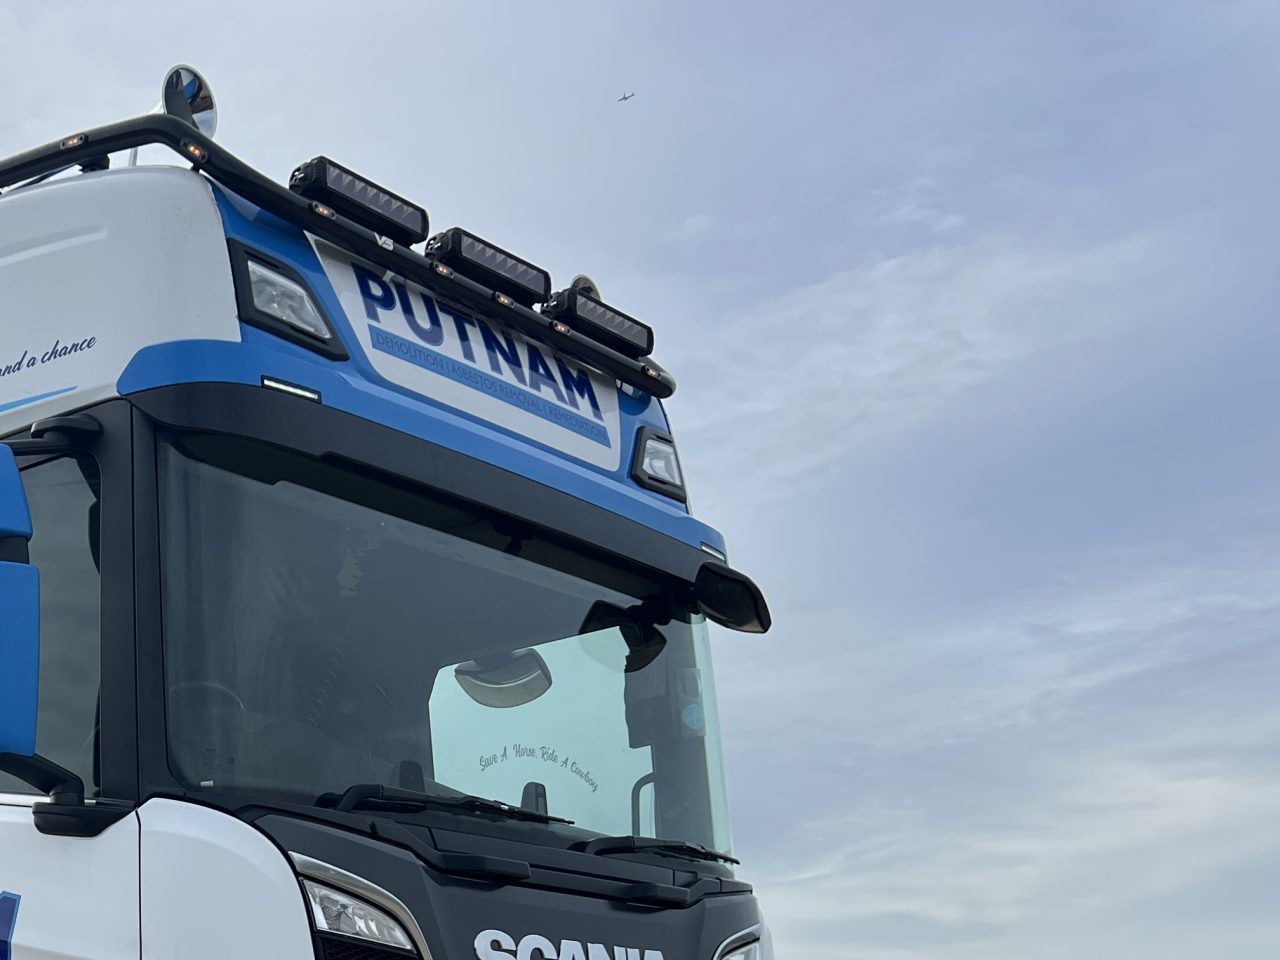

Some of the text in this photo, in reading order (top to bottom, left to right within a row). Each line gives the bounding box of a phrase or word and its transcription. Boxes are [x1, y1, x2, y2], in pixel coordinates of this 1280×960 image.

[26, 356, 38, 368] a
[40, 336, 98, 364] chance
[351, 261, 604, 421] PUTNAM
[375, 332, 608, 442] DEMOLITION ASBESTOS REMOVAL REMEDIATION
[479, 754, 498, 771] Save
[500, 746, 508, 762] A
[540, 746, 558, 762] Ride
[560, 757, 569, 768] A
[570, 761, 599, 792] Cowboy
